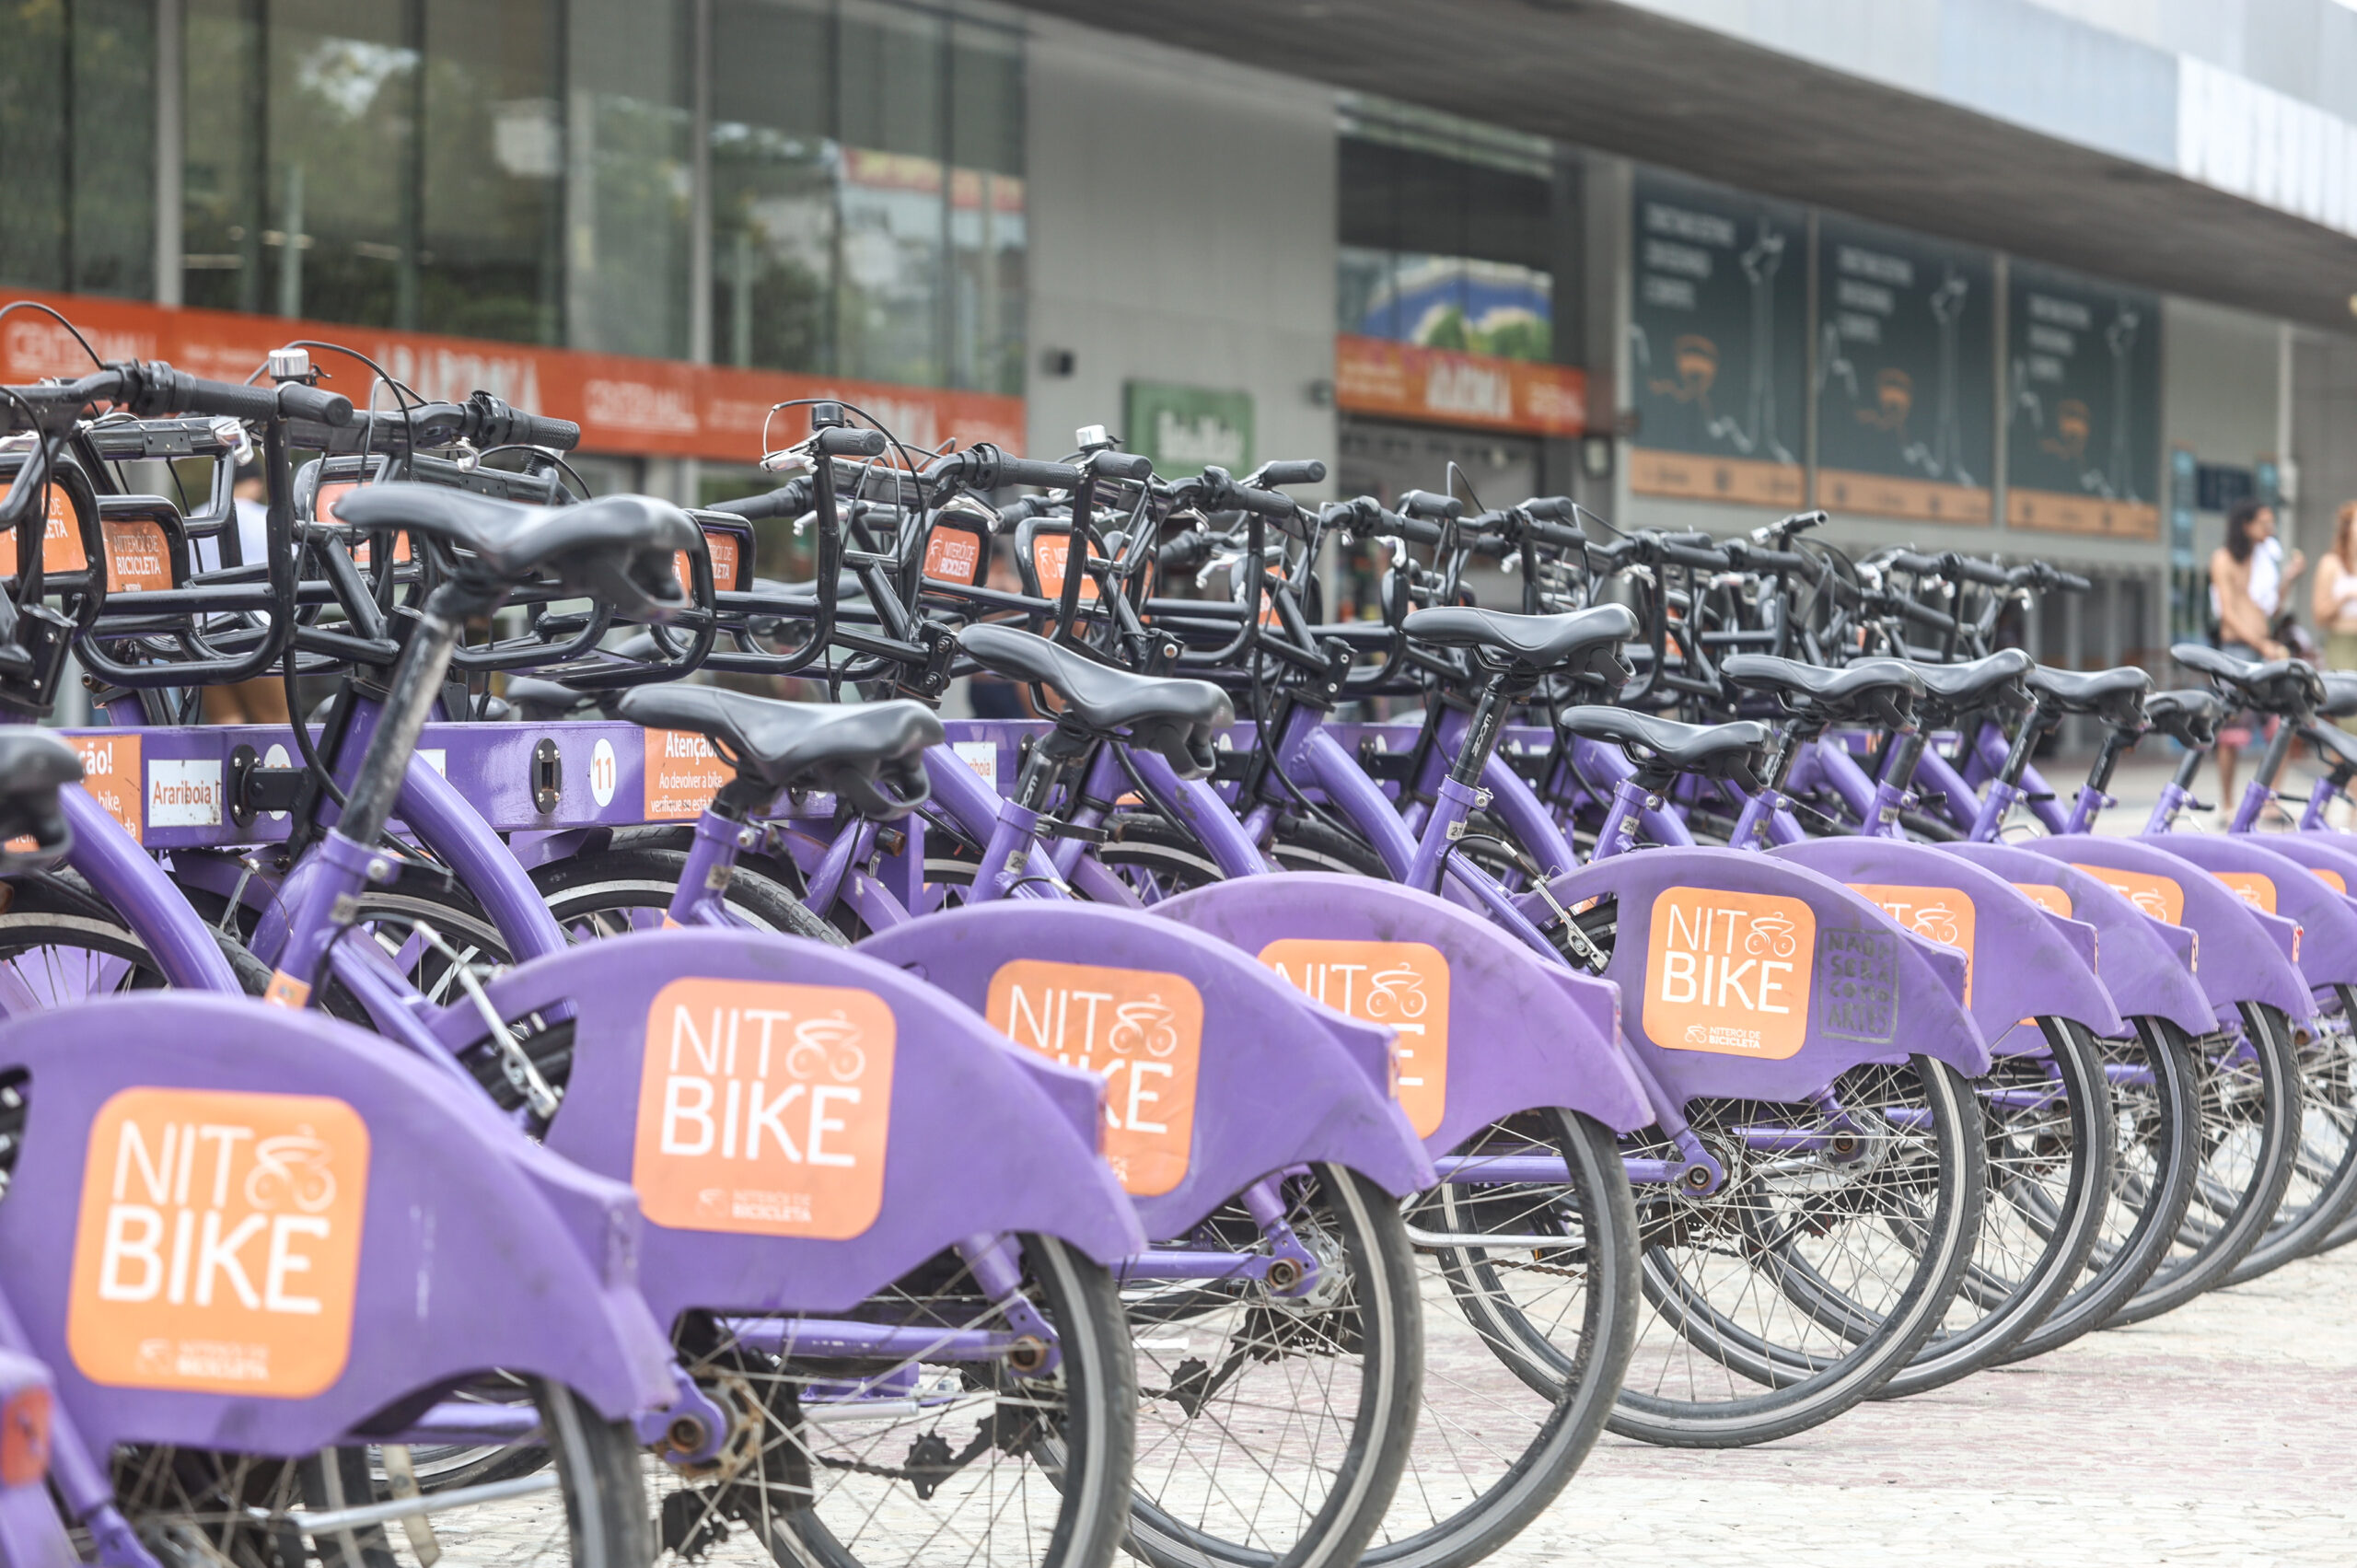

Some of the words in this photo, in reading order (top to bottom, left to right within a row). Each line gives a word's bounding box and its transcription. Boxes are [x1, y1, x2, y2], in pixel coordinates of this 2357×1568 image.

[147, 534, 159, 552] DE
[116, 555, 162, 575] BICICLETA
[153, 780, 212, 805] Arariboia
[595, 757, 612, 790] 11
[659, 772, 669, 789] Ao
[670, 771, 701, 789] devolver
[702, 775, 706, 789] a
[1667, 904, 1747, 954] NIT
[1662, 950, 1794, 1015] BIKE
[1008, 984, 1113, 1052] NIT
[1748, 1030, 1761, 1040] DE
[668, 1004, 792, 1079] NIT
[1709, 1034, 1761, 1050] BICICLETA
[660, 1074, 862, 1168] BIKE
[112, 1119, 255, 1210] NIT
[98, 1202, 331, 1315] BIKE
